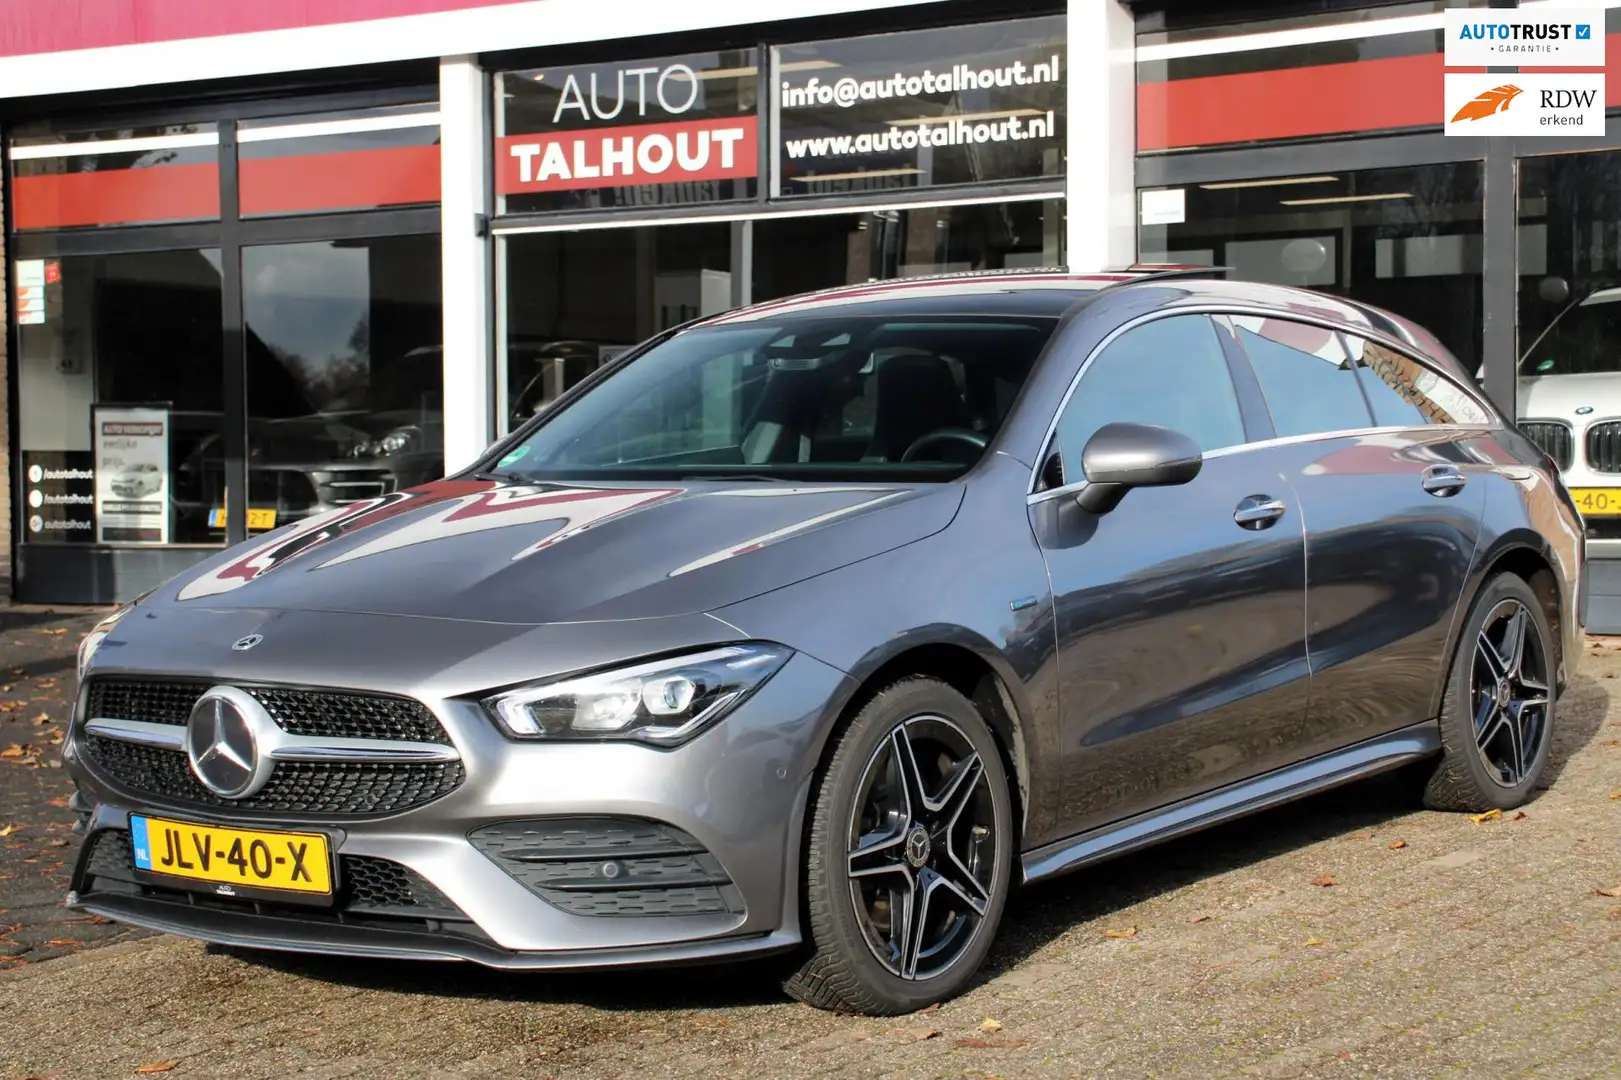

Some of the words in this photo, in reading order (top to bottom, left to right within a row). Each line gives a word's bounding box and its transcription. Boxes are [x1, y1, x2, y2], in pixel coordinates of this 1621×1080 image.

[552, 63, 698, 124] AUTO
[781, 54, 1060, 108] info@autotalhout.nl
[510, 127, 744, 183] TALHOUT
[785, 110, 1055, 159] www.autotalhout.nl
[135, 847, 149, 862] NL
[160, 828, 313, 883] JLV-40-X
